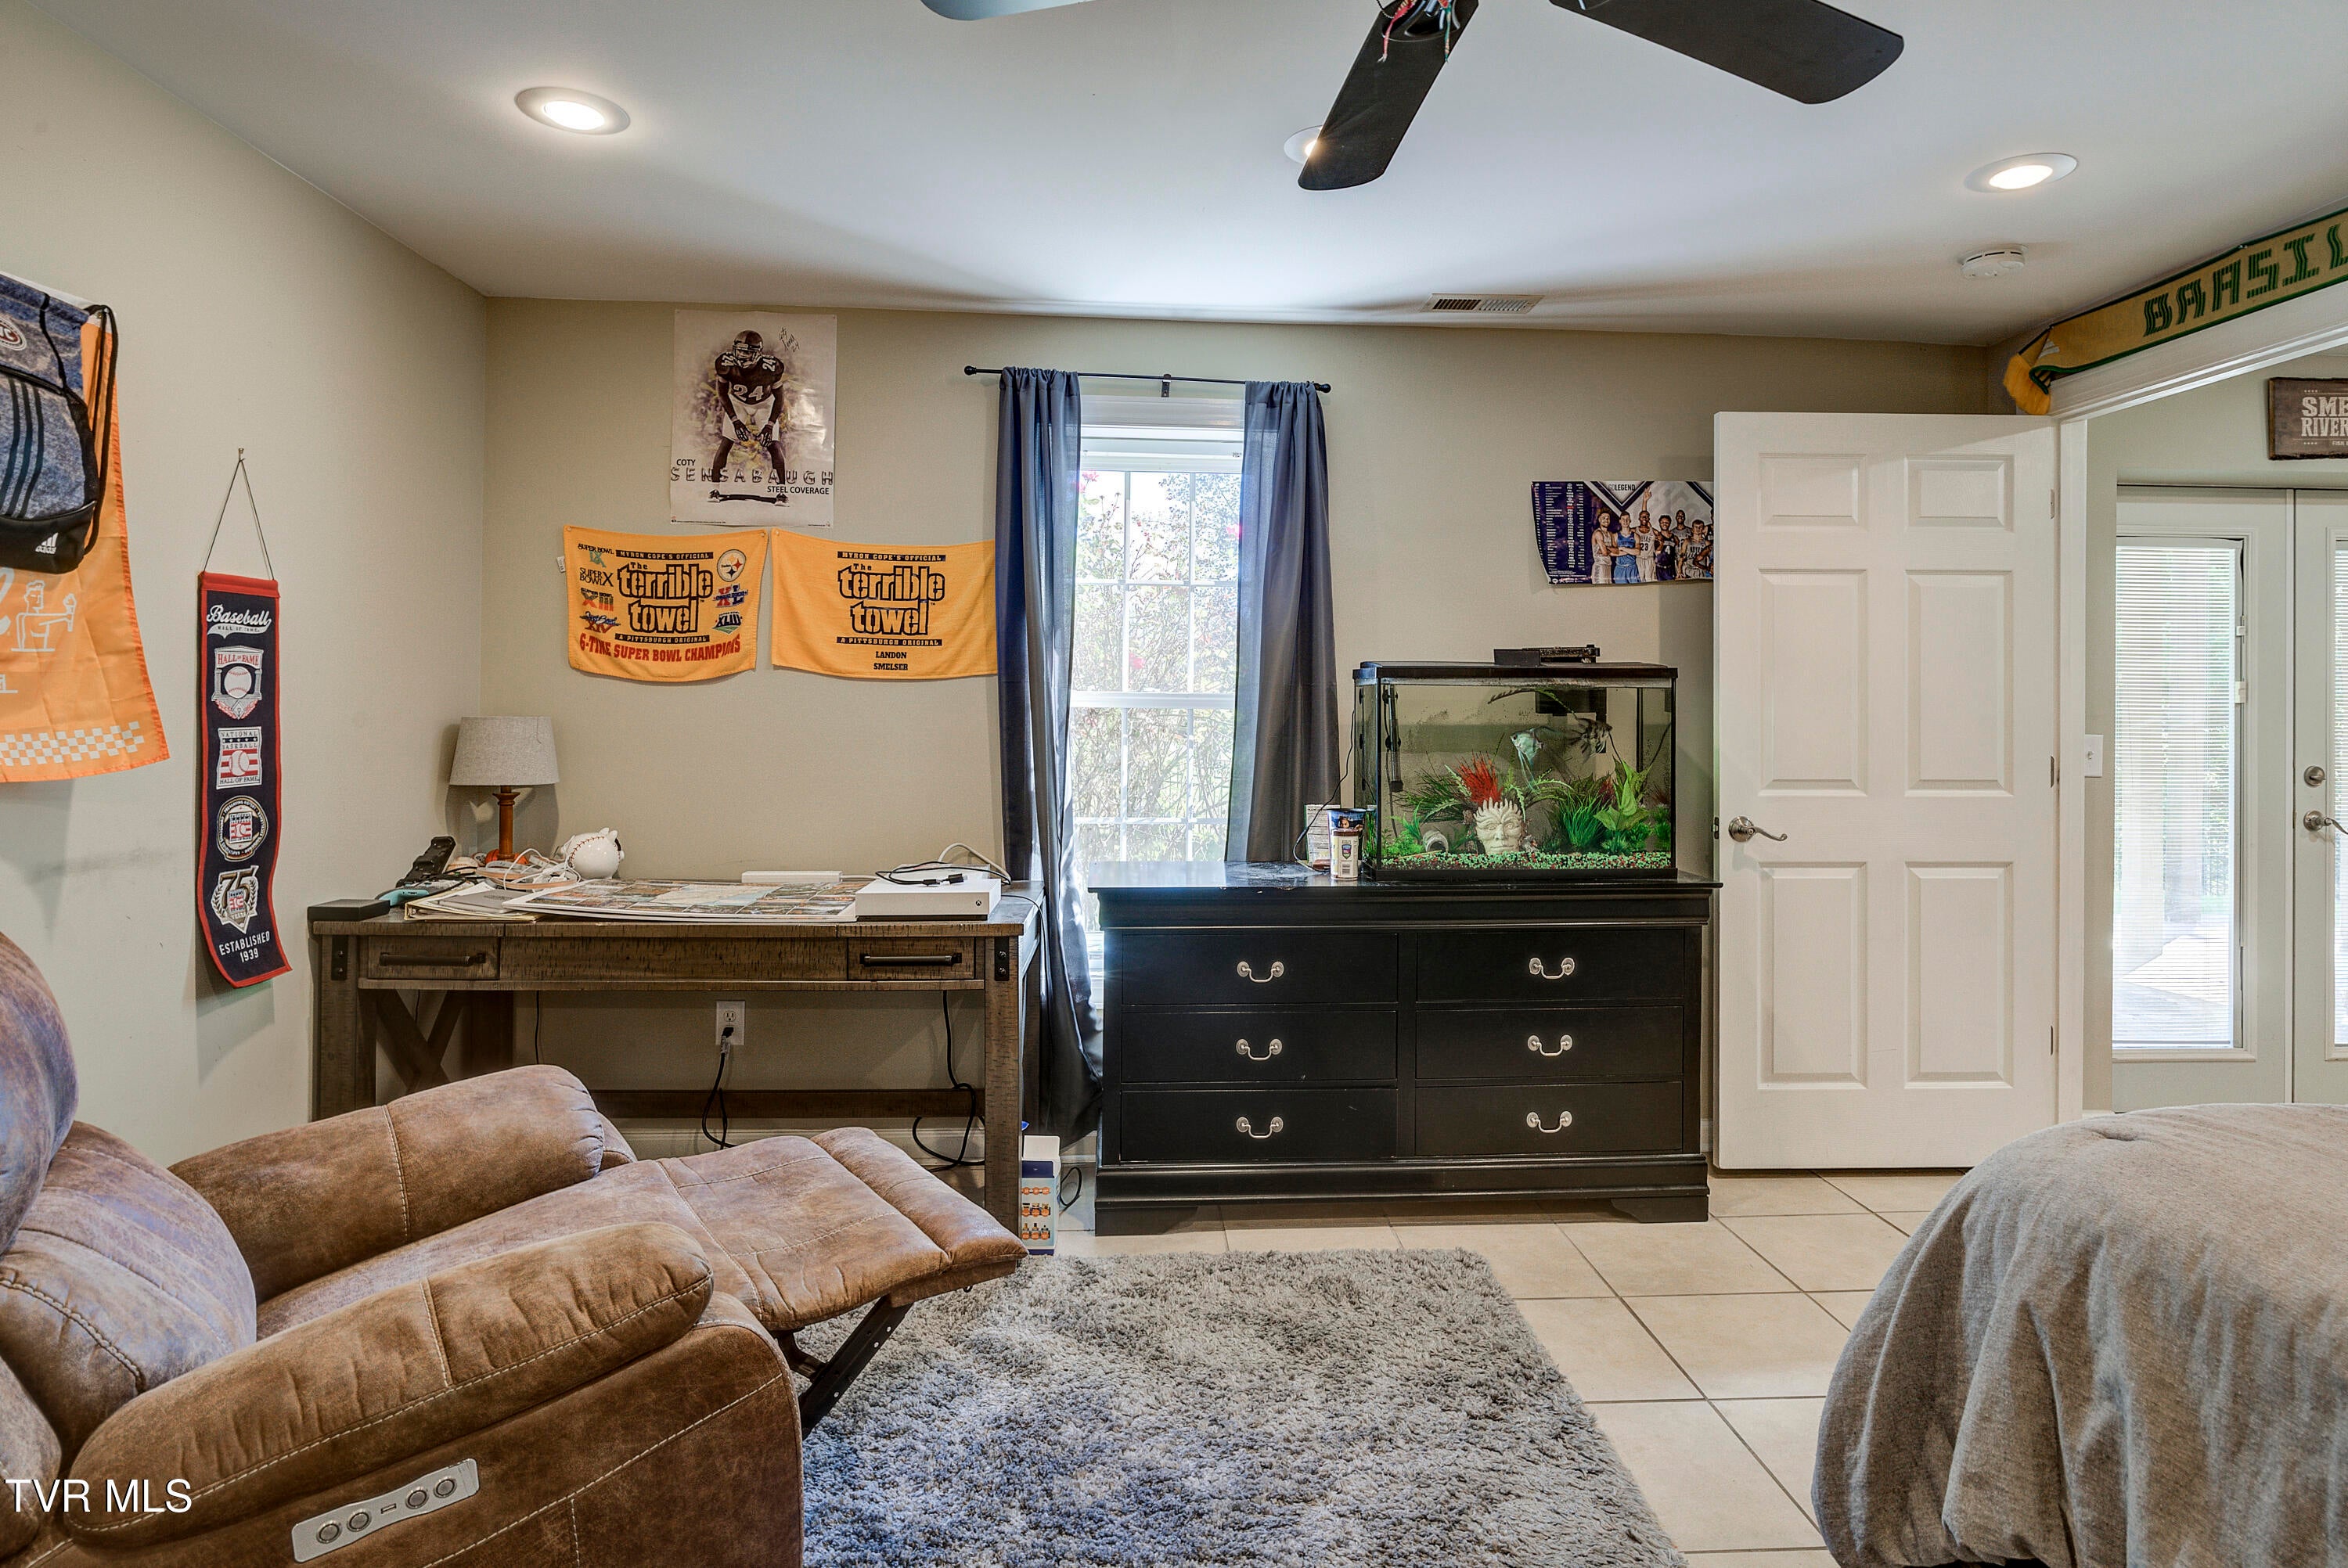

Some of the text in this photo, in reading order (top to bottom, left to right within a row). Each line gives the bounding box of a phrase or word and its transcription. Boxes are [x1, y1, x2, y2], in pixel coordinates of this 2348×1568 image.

[733, 384, 764, 401] 24
[2301, 396, 2348, 417] SME
[2301, 417, 2348, 437] RIVER
[671, 467, 834, 486] SENSABAUGH
[790, 486, 830, 494] COVERAGE
[597, 546, 614, 555] BOWL
[580, 567, 603, 579] SUPER
[580, 571, 614, 587] BOWL X
[617, 563, 713, 600] terrible
[837, 565, 945, 602] terrible
[206, 604, 272, 626] Baseball
[628, 598, 699, 634] towel
[715, 613, 742, 628] XLIII
[850, 599, 929, 635] towel
[580, 632, 611, 656] 6-TIME
[614, 644, 649, 661] SUPER
[653, 649, 682, 662] BOWL
[674, 635, 707, 644] ORIGINAL
[848, 637, 899, 646] PITTSBURGH
[218, 653, 237, 665] HALL
[242, 655, 259, 666] FAME
[873, 662, 909, 671] SMELSER
[219, 866, 256, 909] 75
[218, 930, 271, 956] ESTABLISHED
[239, 948, 260, 963] 1939
